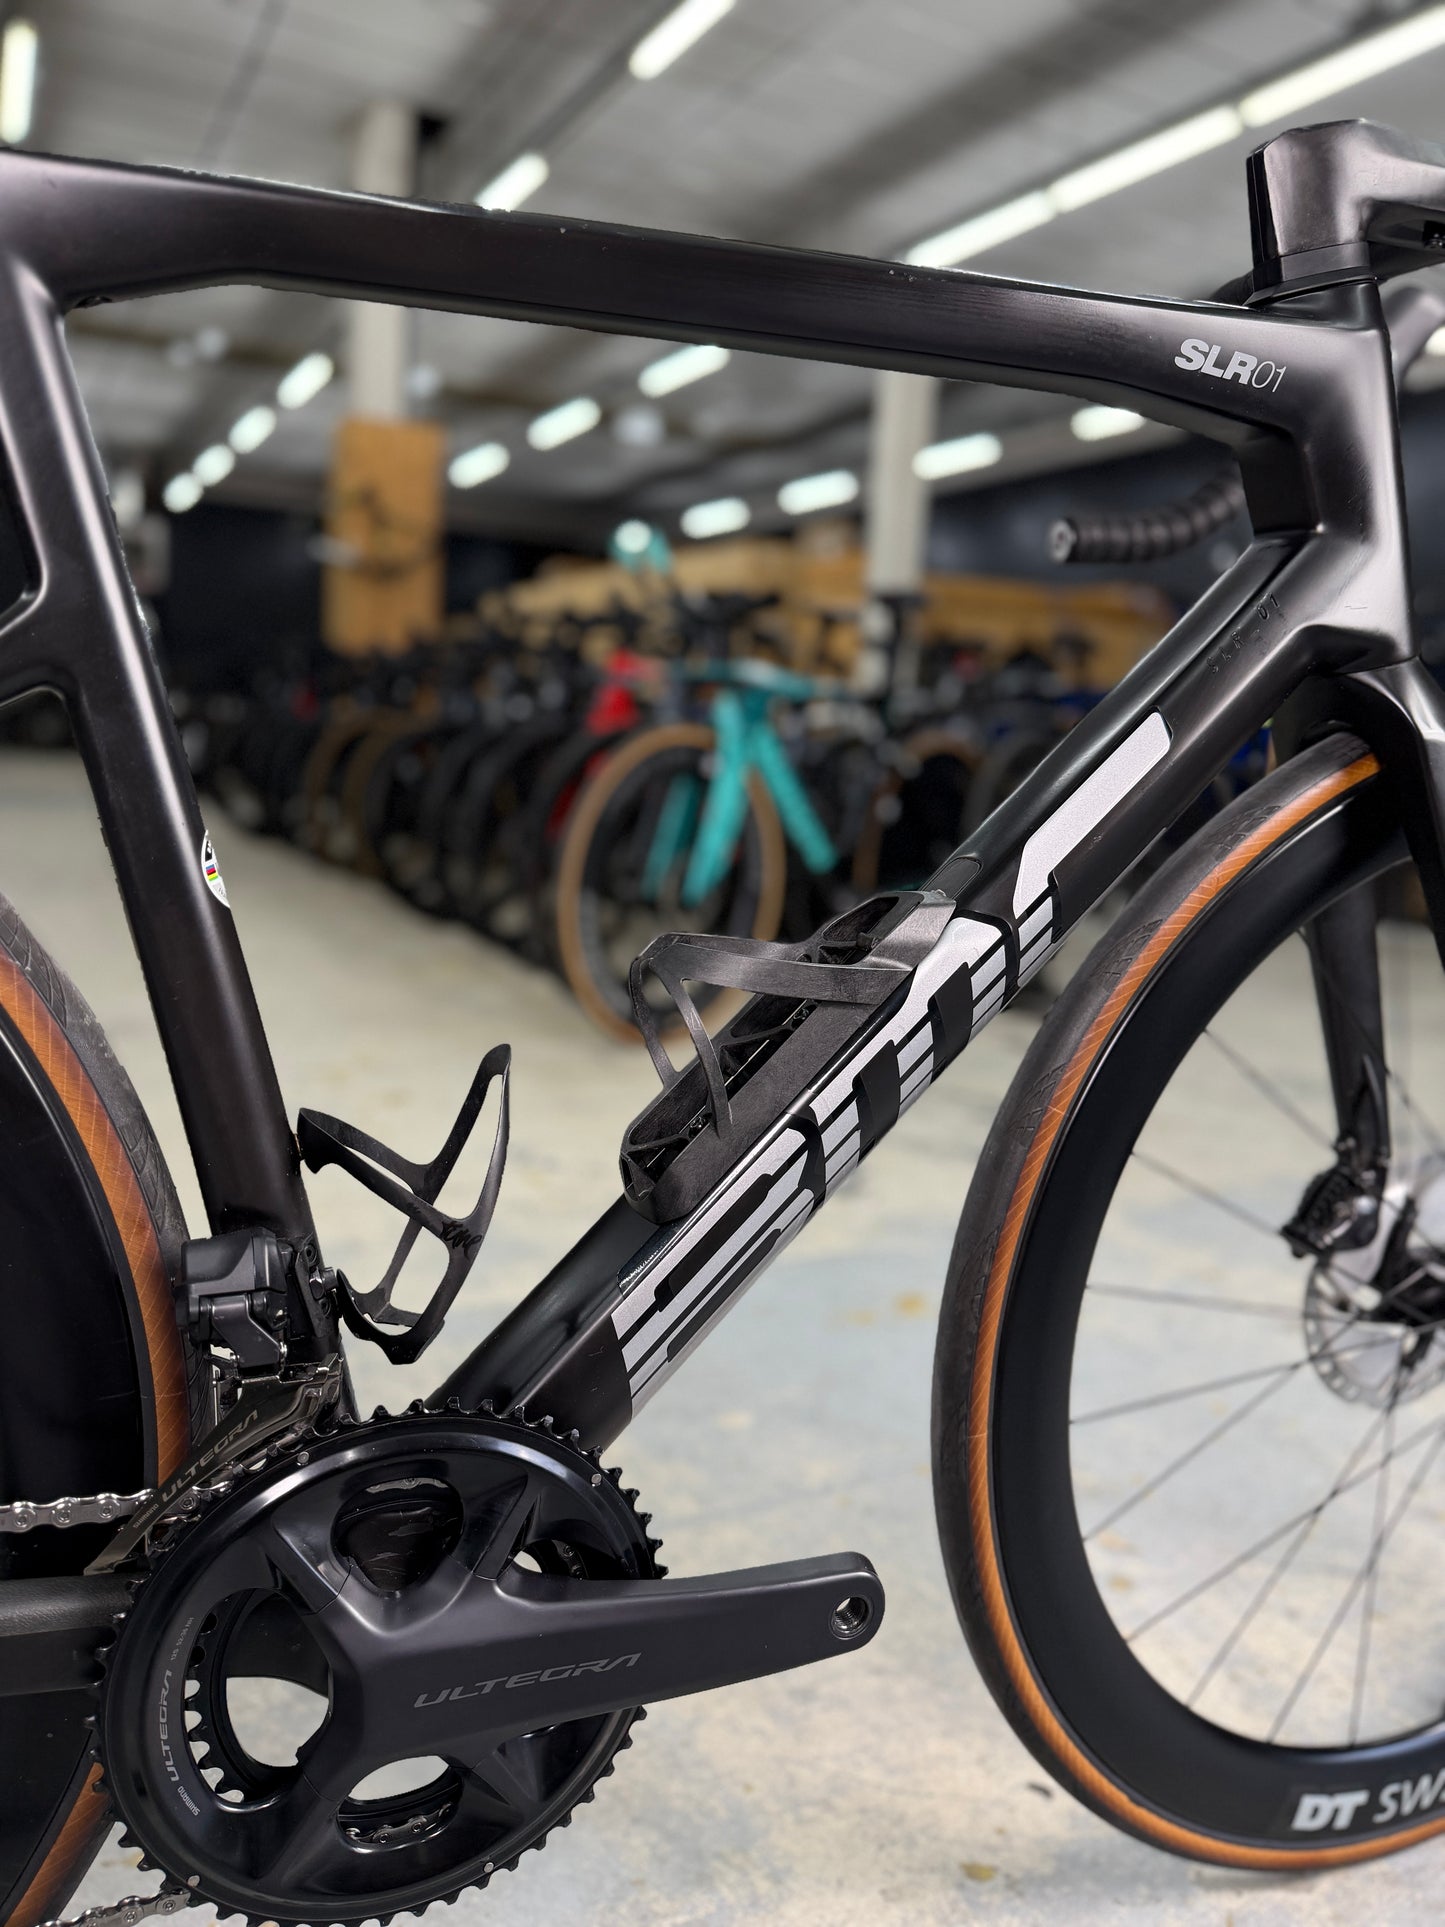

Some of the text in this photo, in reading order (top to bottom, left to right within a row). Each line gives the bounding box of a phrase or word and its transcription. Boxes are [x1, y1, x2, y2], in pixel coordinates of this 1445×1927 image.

[1174, 338, 1287, 393] SLR01
[162, 1410, 258, 1502] ULTEGRA
[413, 1652, 642, 1708] ULTEGRA
[159, 1670, 180, 1782] ULTEGRA
[177, 1785, 201, 1816] SHIMANO
[1290, 1767, 1445, 1832] DT SW
